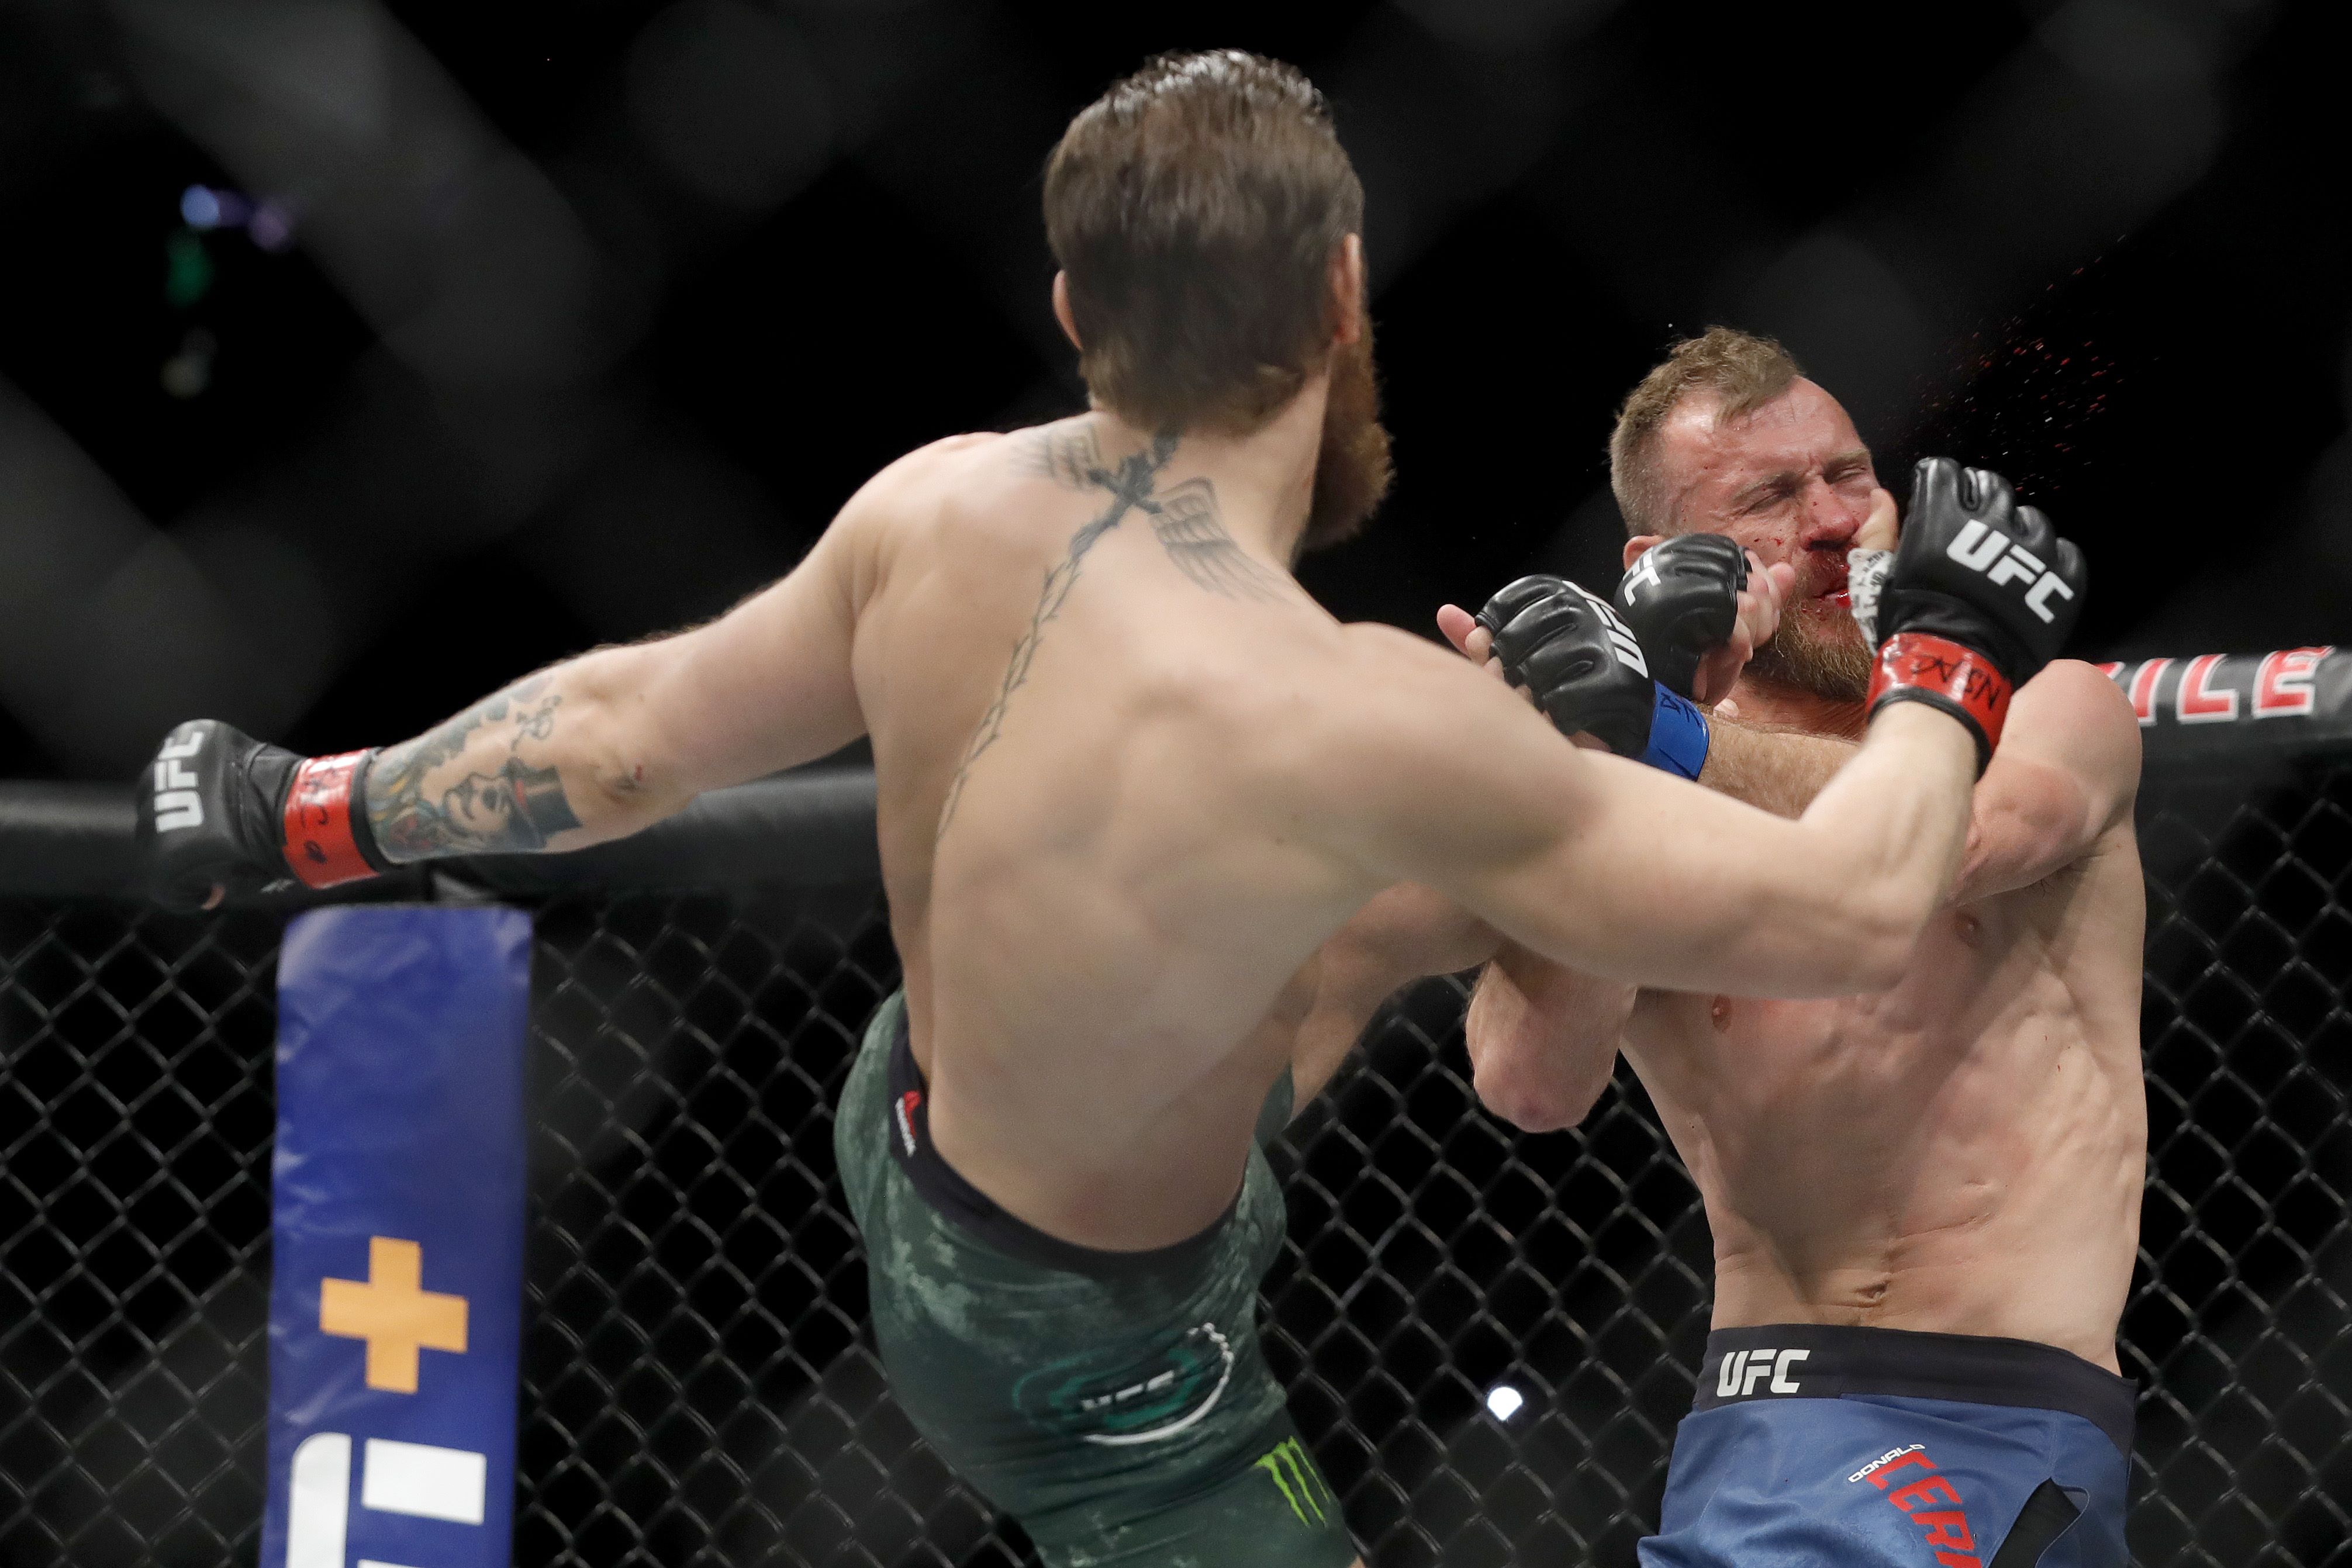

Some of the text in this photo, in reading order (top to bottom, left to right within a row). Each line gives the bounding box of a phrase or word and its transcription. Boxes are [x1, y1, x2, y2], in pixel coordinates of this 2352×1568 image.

[1946, 519, 2074, 623] UFC
[2093, 645, 2337, 726] ILE
[154, 731, 205, 834] UFC
[1716, 1349, 1811, 1397] UFC
[1847, 1443, 1925, 1483] DONALD
